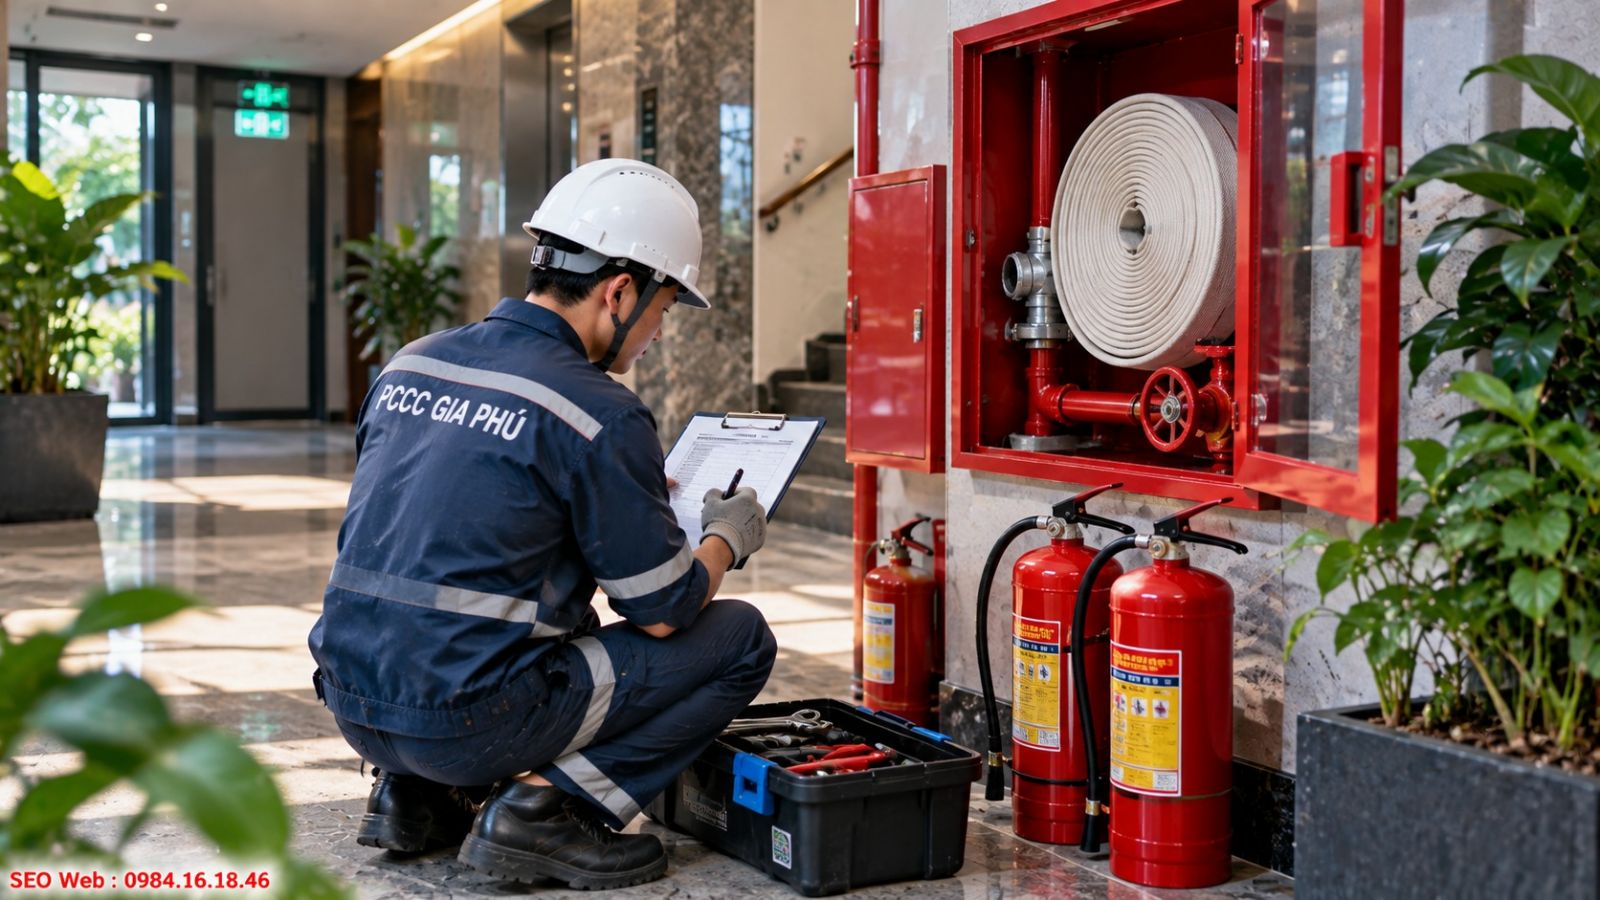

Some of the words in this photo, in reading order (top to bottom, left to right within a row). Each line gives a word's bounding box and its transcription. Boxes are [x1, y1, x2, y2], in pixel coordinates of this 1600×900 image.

[375, 384, 432, 416] PCCC
[431, 395, 470, 426] GIA
[468, 402, 528, 441] PHÚ
